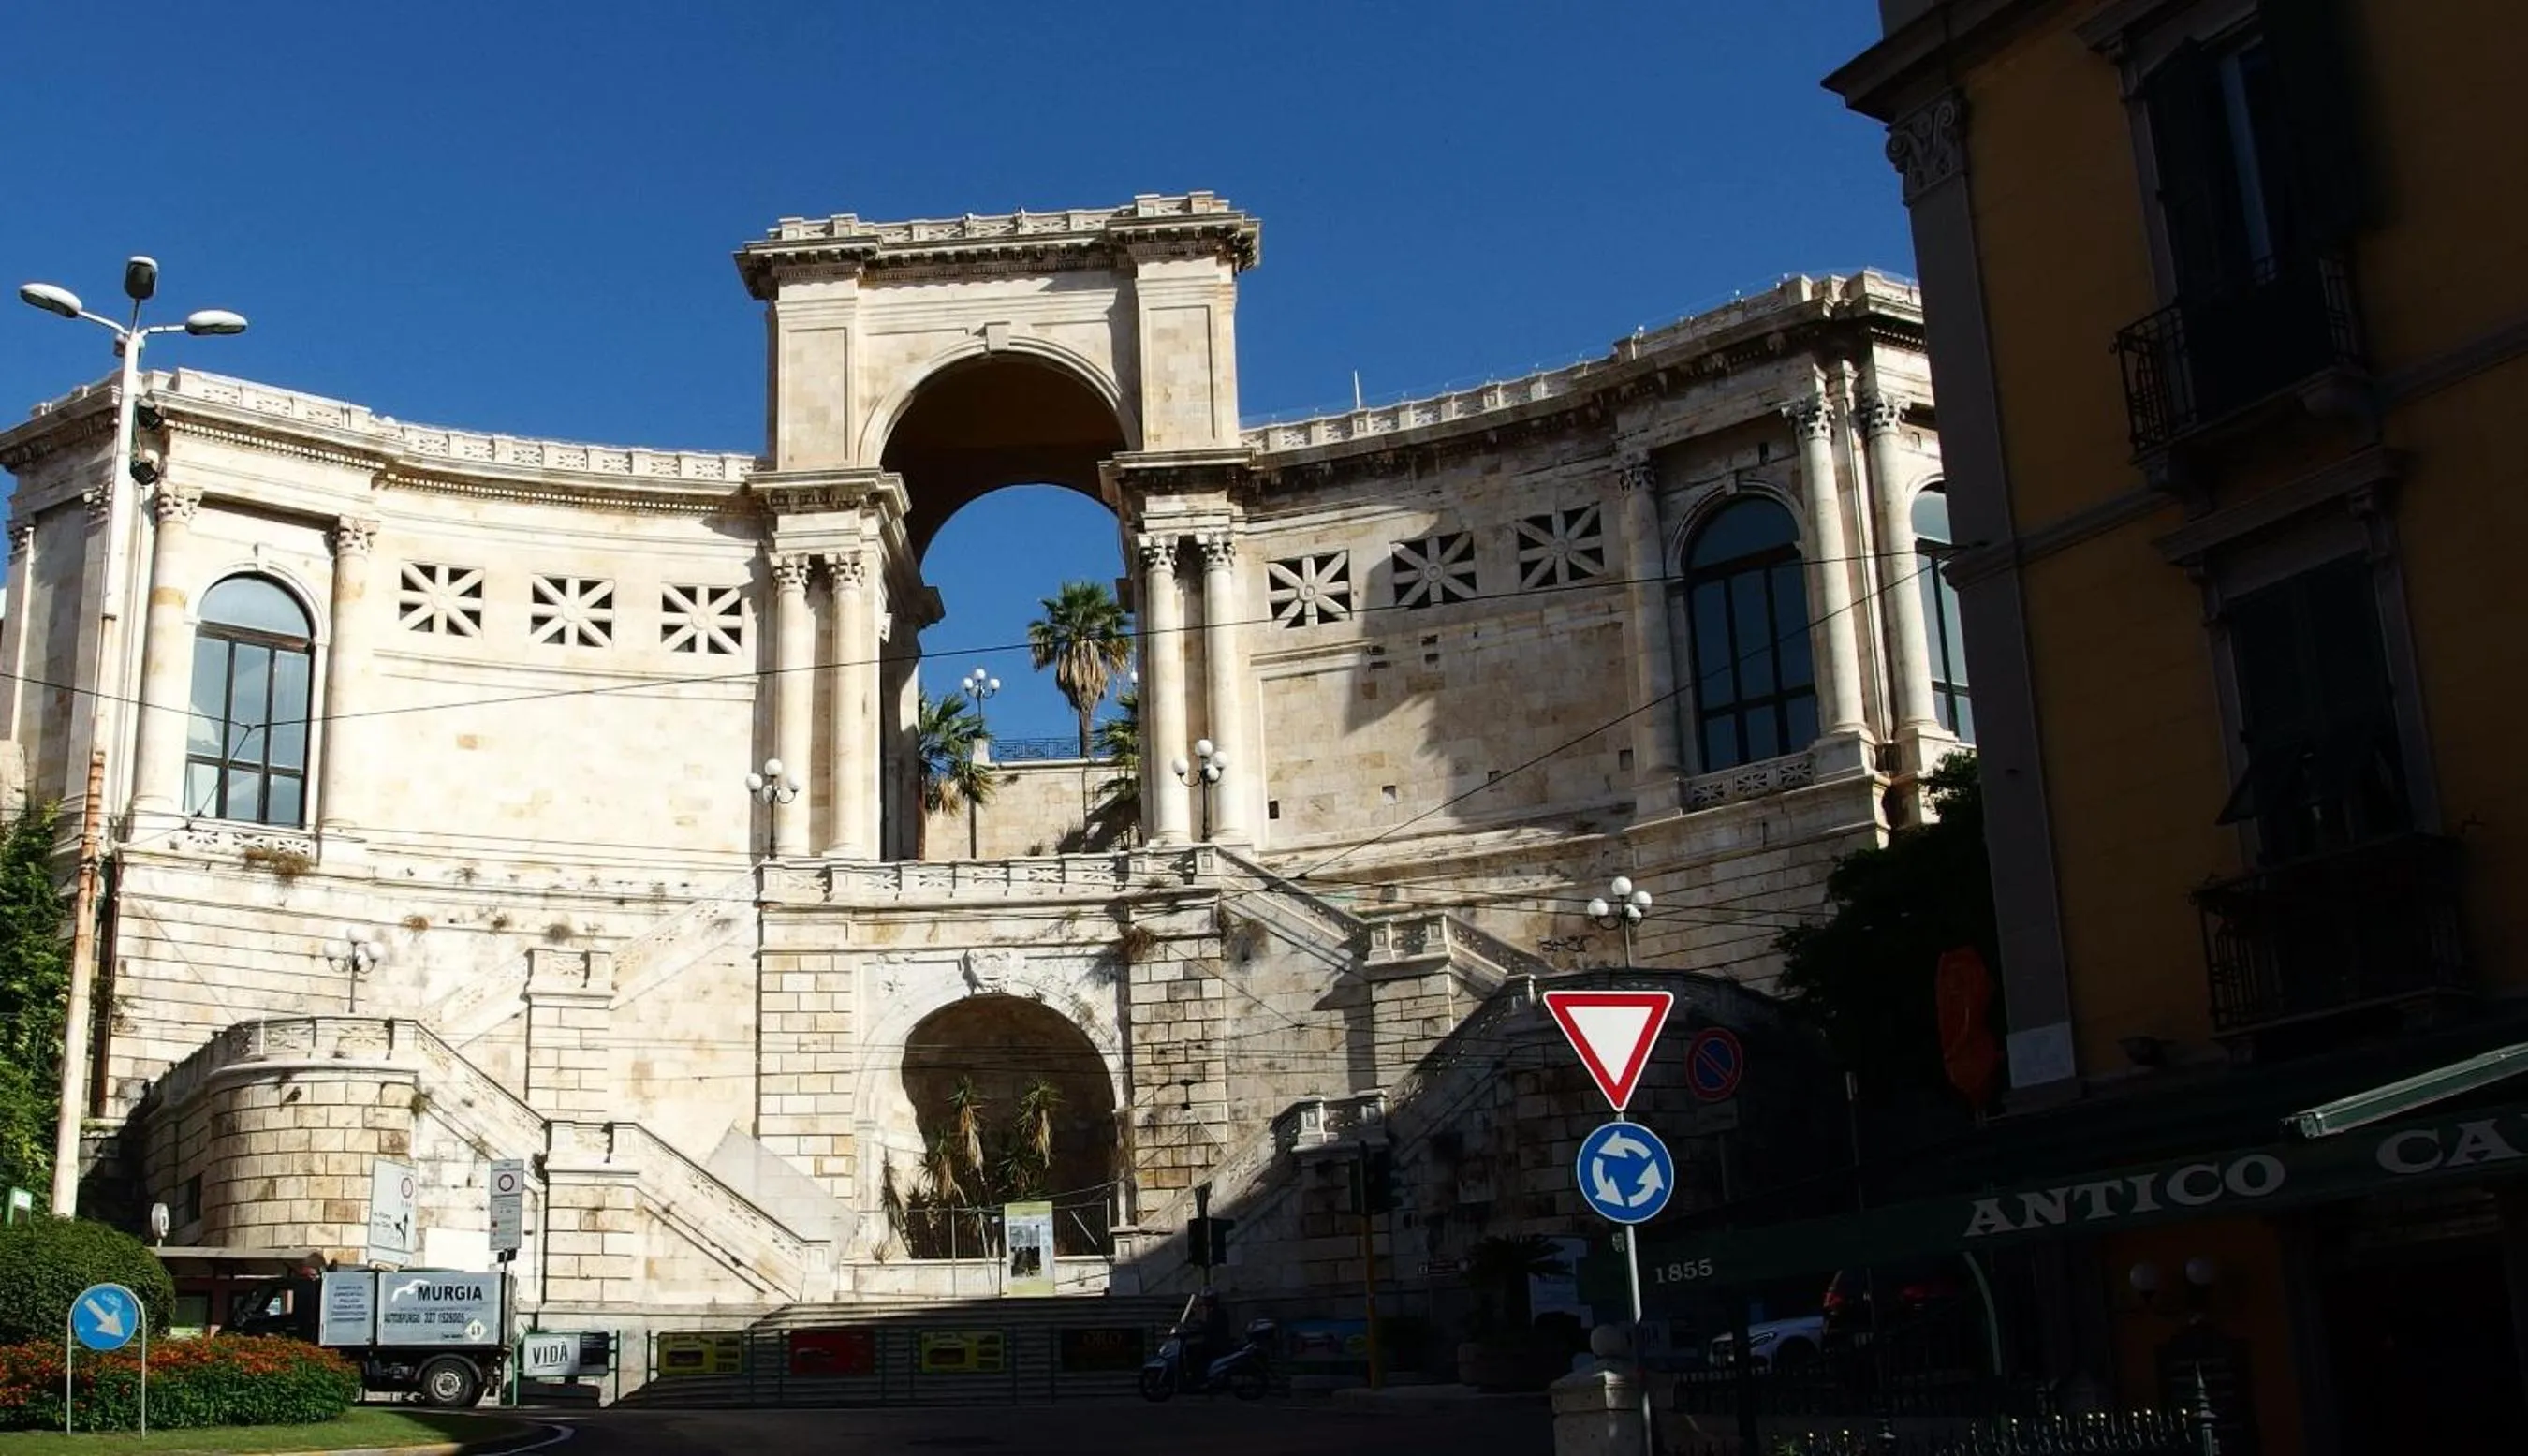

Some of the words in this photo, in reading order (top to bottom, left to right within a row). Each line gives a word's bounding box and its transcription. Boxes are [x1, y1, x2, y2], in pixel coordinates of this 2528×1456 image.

[1963, 1153, 2286, 1237] ANTICO
[2375, 1113, 2528, 1175] CA
[1654, 1257, 1713, 1284] 1855
[417, 1285, 483, 1301] MURGIA
[533, 1341, 568, 1364] VIDÀ
